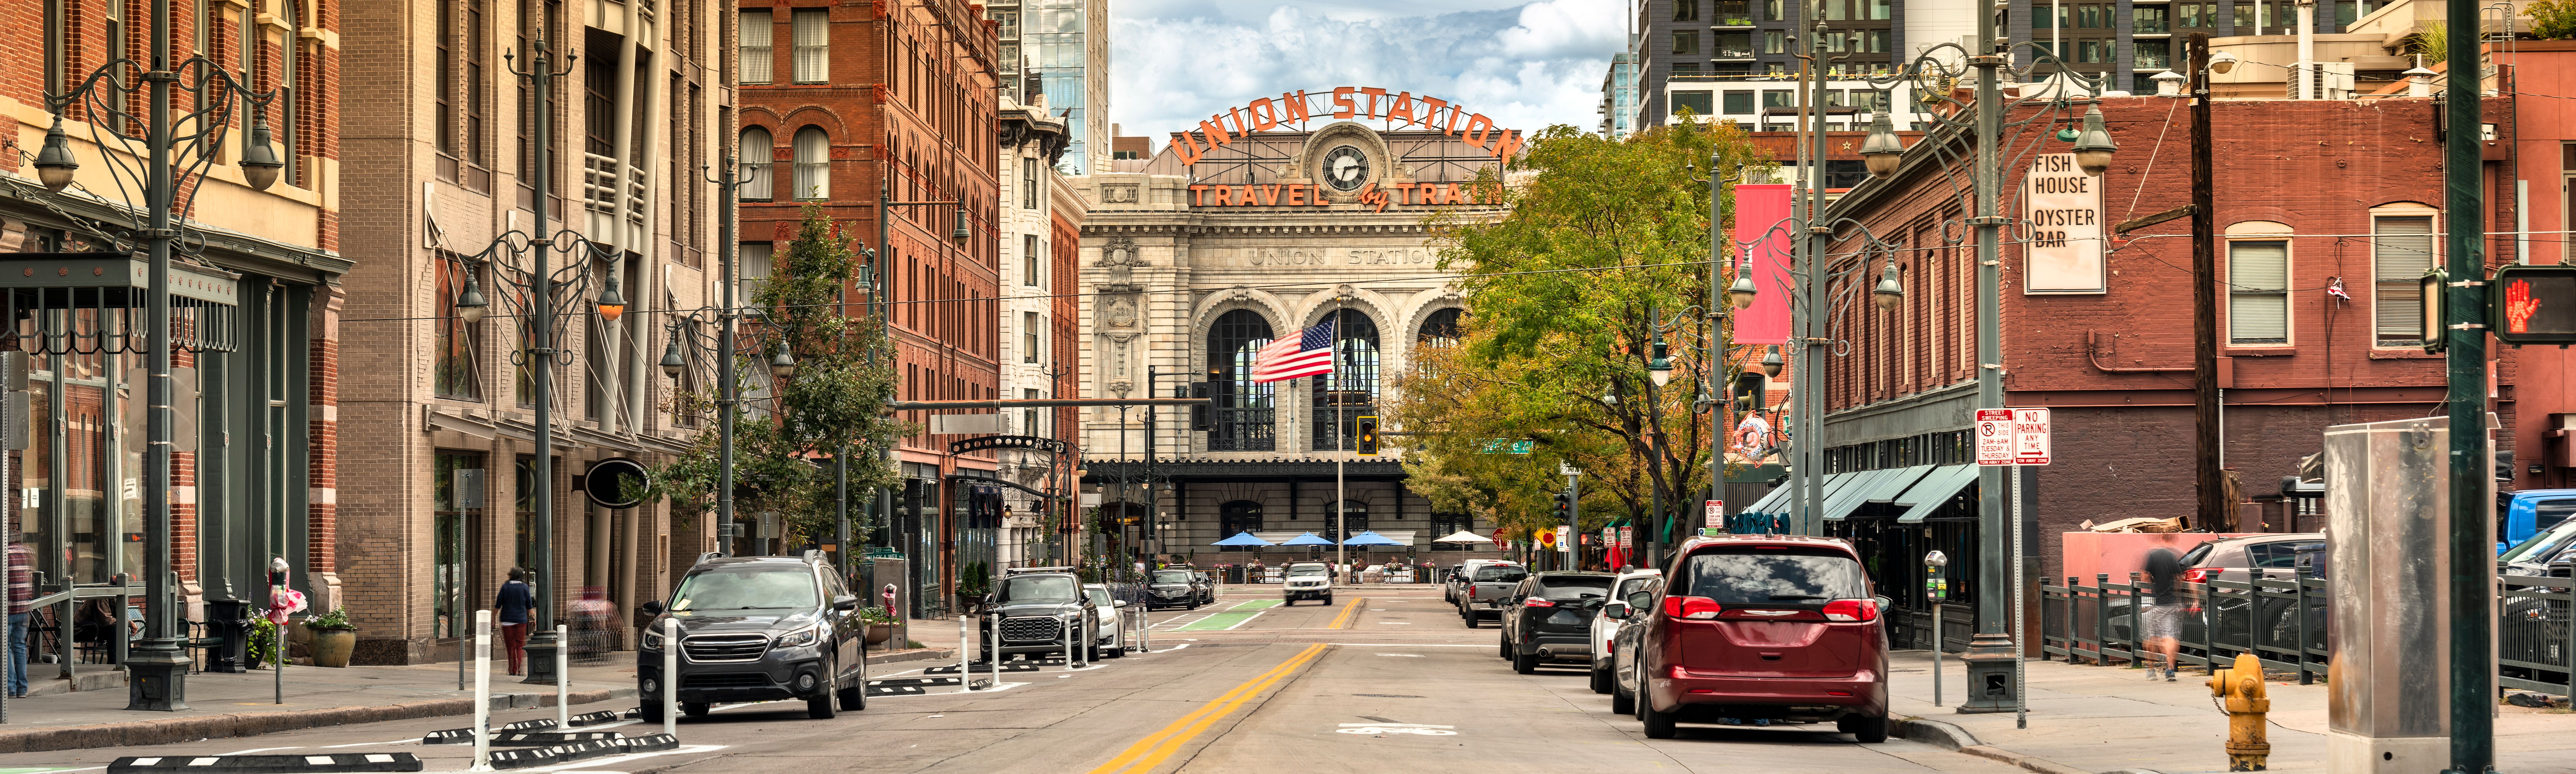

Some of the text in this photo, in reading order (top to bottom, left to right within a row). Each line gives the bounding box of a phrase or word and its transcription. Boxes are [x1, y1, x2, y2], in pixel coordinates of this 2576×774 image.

[1170, 86, 1524, 166] UNION STATION
[2035, 156, 2071, 172] FISH
[2036, 177, 2088, 193] HOUSE
[1190, 182, 1502, 213] TRAVEL by TRAIN
[2035, 209, 2095, 226] OYSTER
[2036, 231, 2066, 247] BAR
[1249, 249, 1440, 265] UNION STATION
[2026, 412, 2038, 422] NO
[2018, 423, 2046, 433] PARKING
